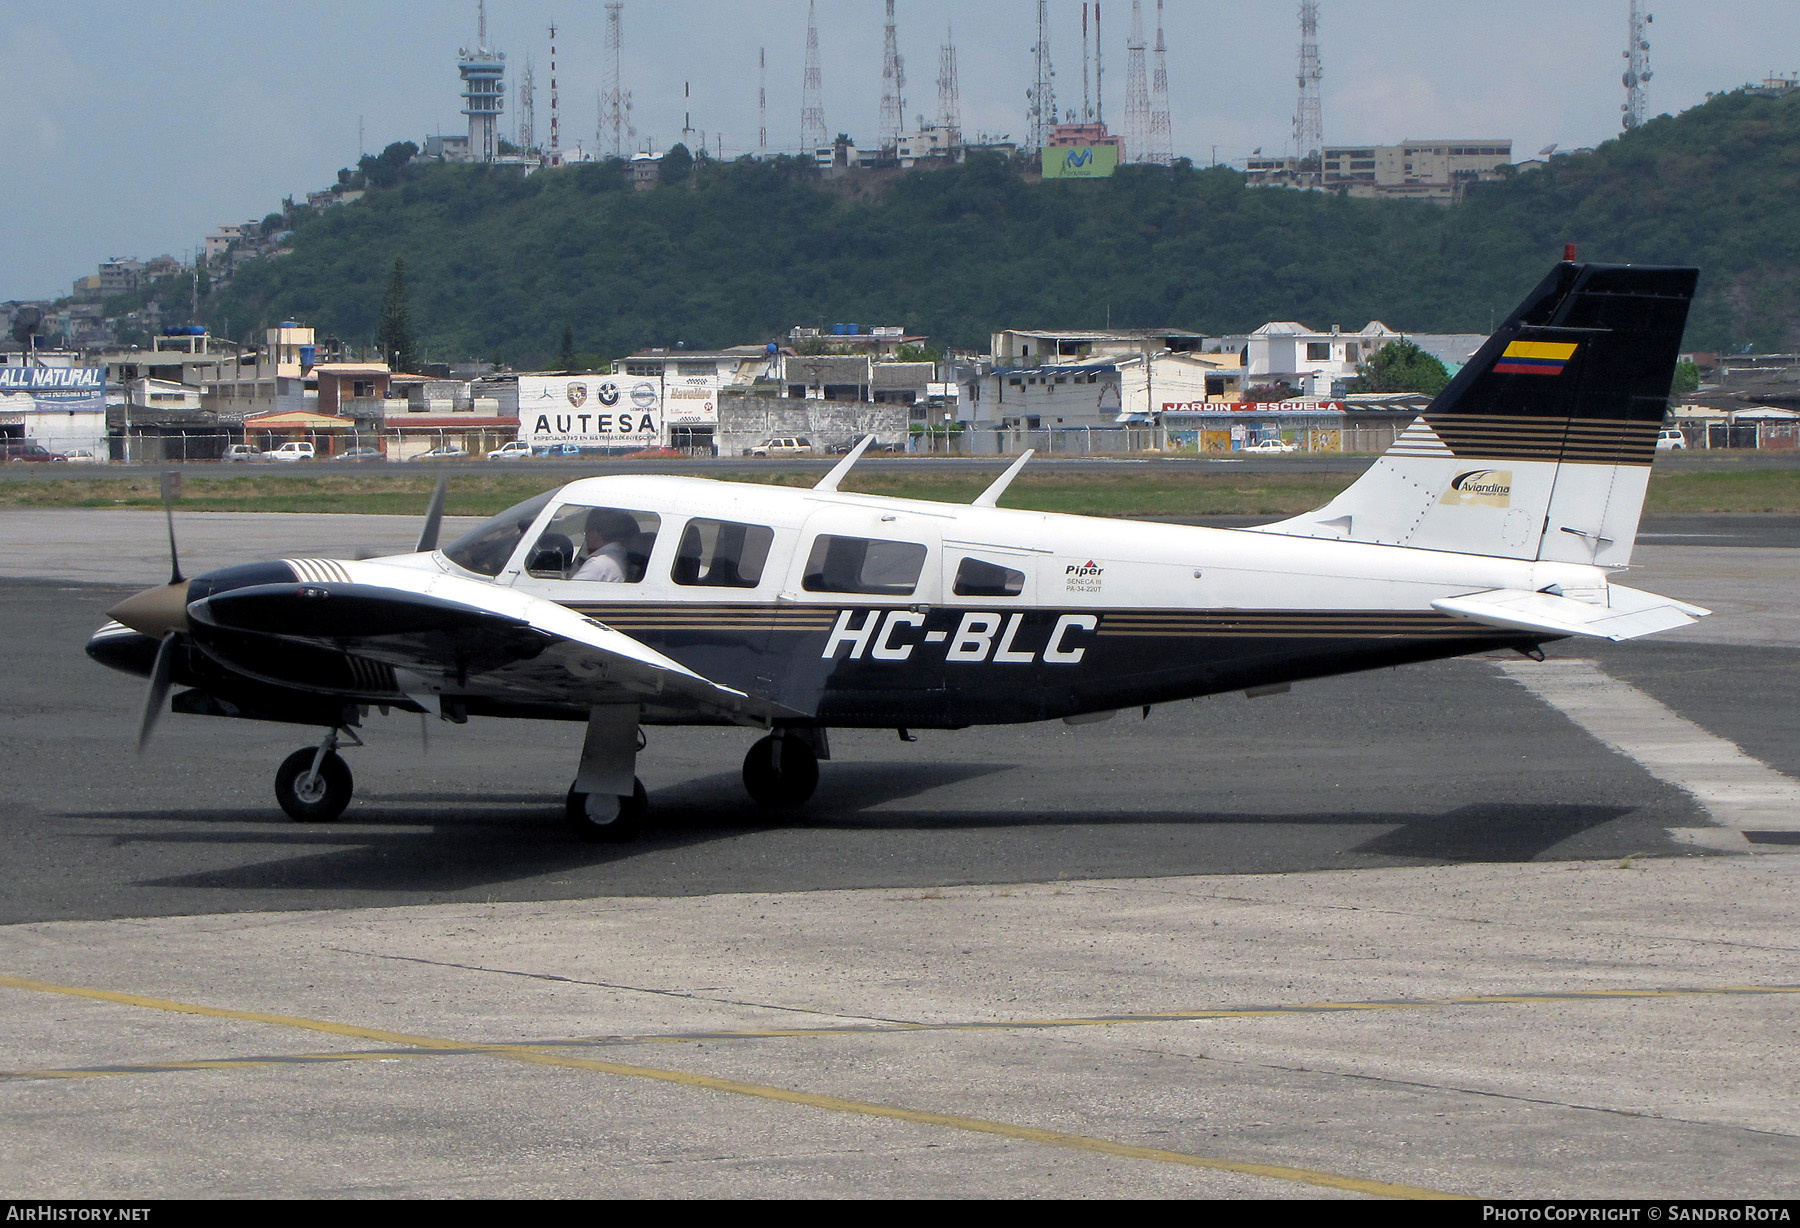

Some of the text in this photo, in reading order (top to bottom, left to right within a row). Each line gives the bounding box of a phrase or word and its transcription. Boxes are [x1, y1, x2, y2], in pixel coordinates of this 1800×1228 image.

[0, 368, 101, 386] ALL NATURAL
[1166, 403, 1232, 411] JARDIN
[1256, 402, 1339, 411] ESCUELA
[534, 414, 656, 433] AUTESA
[1461, 482, 1510, 493] Aviandina
[1065, 565, 1105, 577] Piper
[821, 610, 1098, 663] HC-BLC
